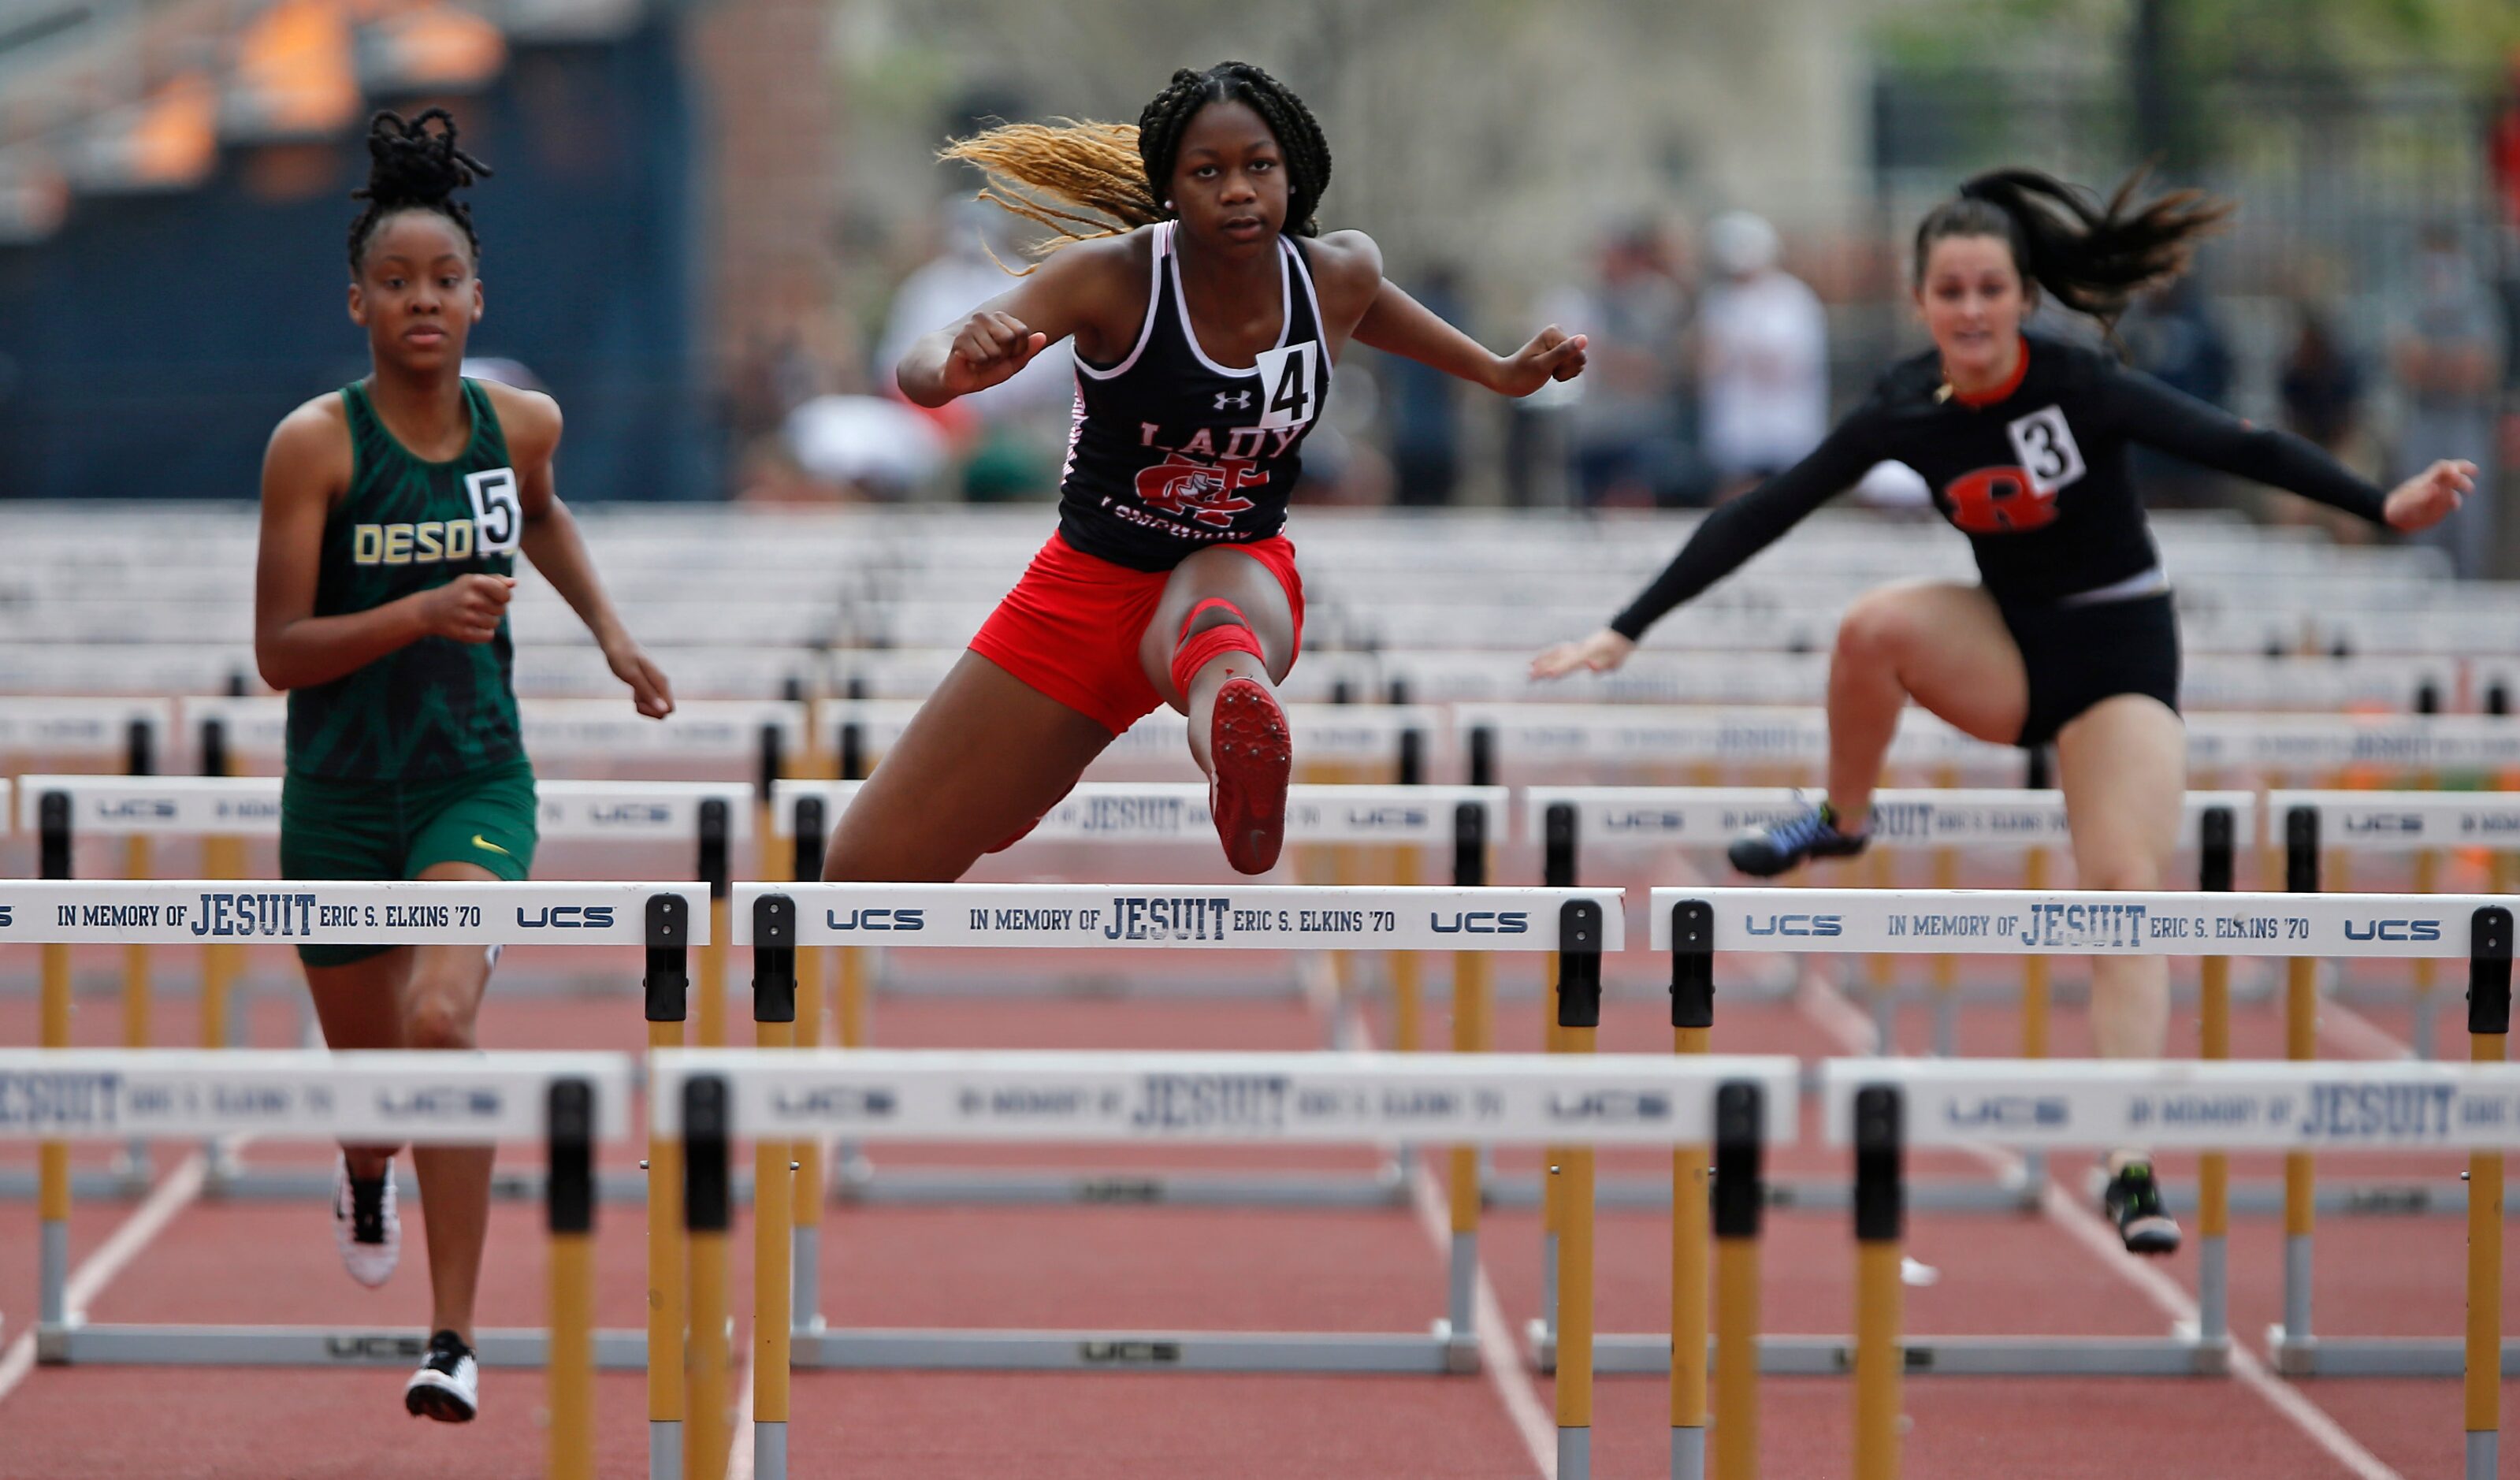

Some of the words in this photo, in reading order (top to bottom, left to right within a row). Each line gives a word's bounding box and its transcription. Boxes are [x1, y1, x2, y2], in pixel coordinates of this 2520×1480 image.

[1269, 349, 1308, 422] 4
[2023, 419, 2071, 480] 3
[479, 475, 511, 544] 5
[355, 519, 513, 564] DESO
[1083, 797, 1184, 831] JESUIT
[58, 905, 76, 926] IN
[83, 905, 159, 926] MEMORY
[167, 906, 187, 926] OF
[191, 894, 315, 935] JESUIT
[320, 906, 357, 926] ERIC
[365, 906, 378, 927] S.
[386, 906, 448, 927] ELKINS
[455, 906, 480, 927] '70
[517, 907, 615, 928] UCS
[827, 909, 924, 930] UCS
[970, 909, 988, 929] IN
[996, 909, 1072, 930] MEMORY
[1080, 910, 1100, 930] OF
[1105, 898, 1229, 940] JESUIT
[1234, 910, 1271, 931] ERIC
[1279, 911, 1292, 932] S.
[1300, 911, 1362, 932] ELKINS
[1370, 911, 1394, 932] '70
[1431, 913, 1528, 933] UCS
[1746, 915, 1843, 936] UCS
[1888, 915, 1906, 935] IN
[1913, 916, 1990, 935] MEMORY
[1998, 916, 2018, 936] OF
[2022, 905, 2146, 946] JESUIT
[2150, 917, 2187, 938] ERIC
[2195, 918, 2208, 938] S.
[2216, 918, 2277, 939] ELKINS
[2284, 917, 2308, 939] '70
[2345, 920, 2441, 940] UCS
[1132, 1077, 1292, 1130] JESUIT
[2300, 1084, 2458, 1138] JESUIT
